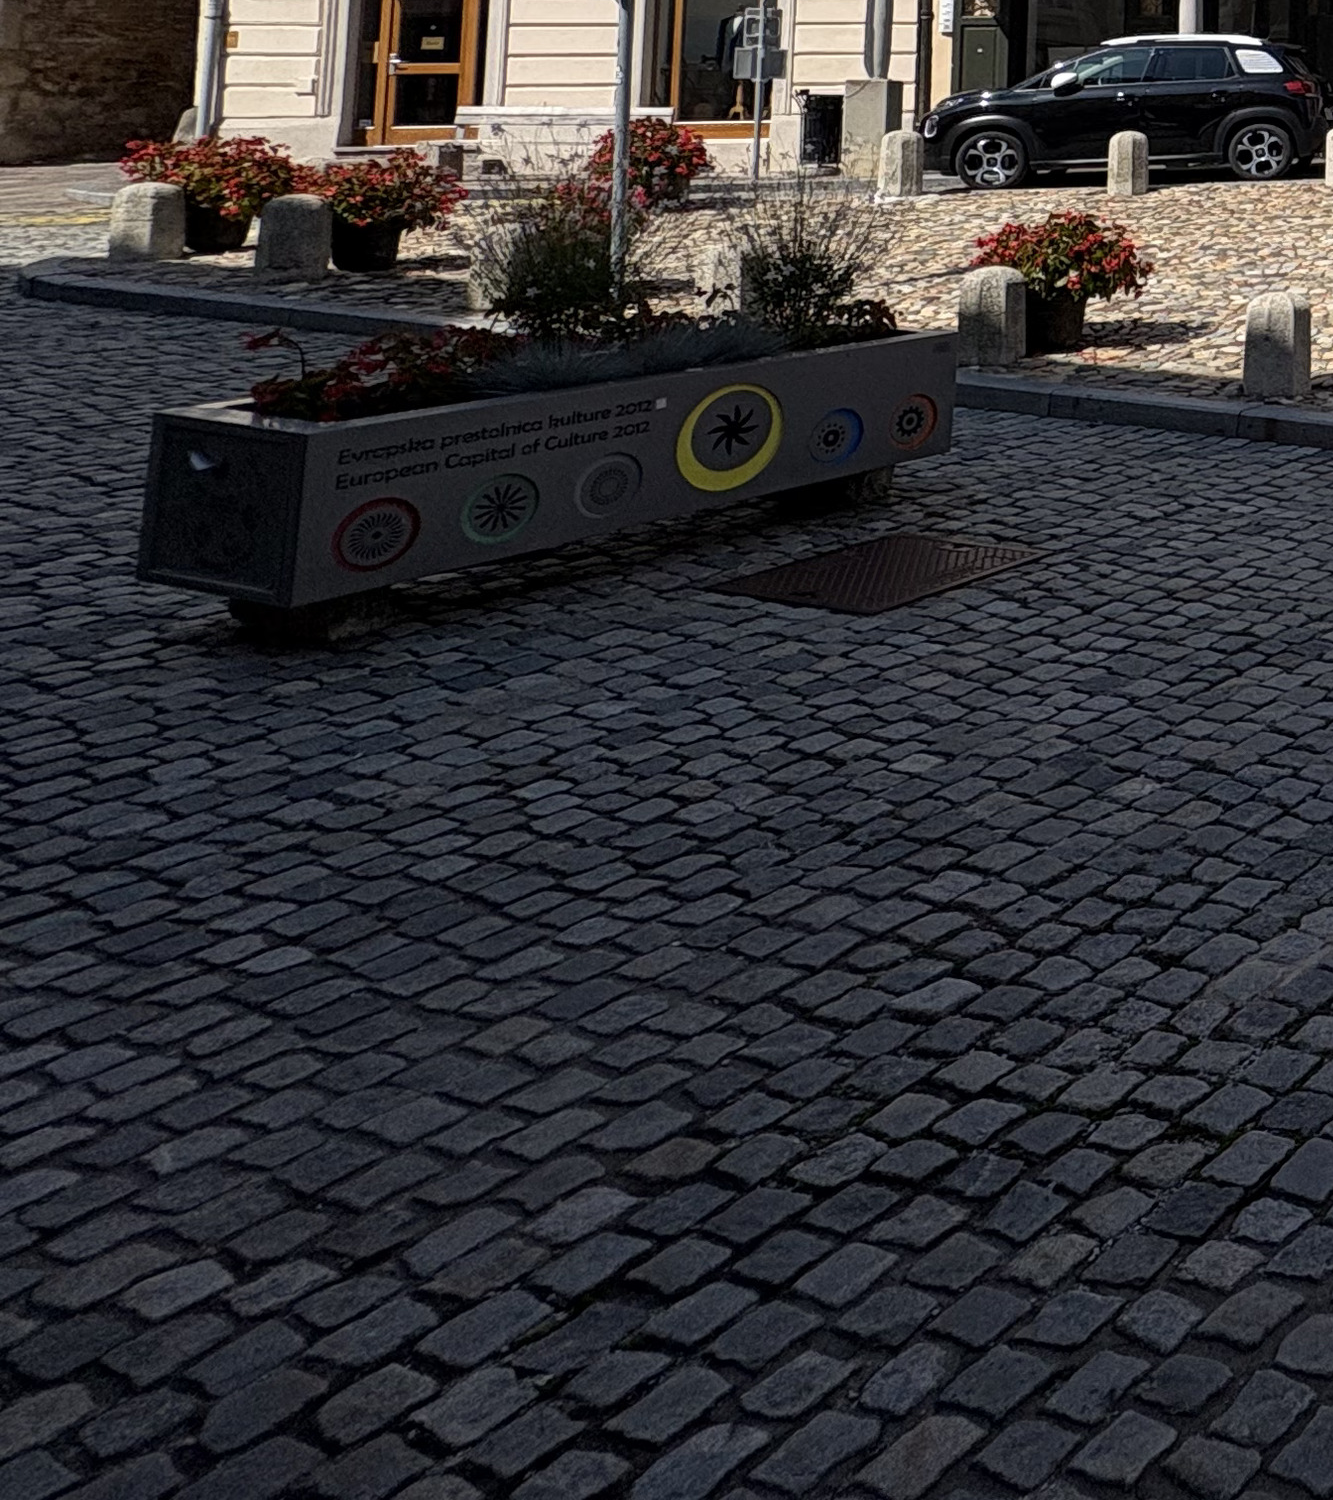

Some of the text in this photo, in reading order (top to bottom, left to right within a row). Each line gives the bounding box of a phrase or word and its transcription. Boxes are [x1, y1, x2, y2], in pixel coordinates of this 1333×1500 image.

[335, 420, 651, 490] European Capital of Culture 2012
[337, 400, 653, 466] Evropska prestolnica kulture 2012
